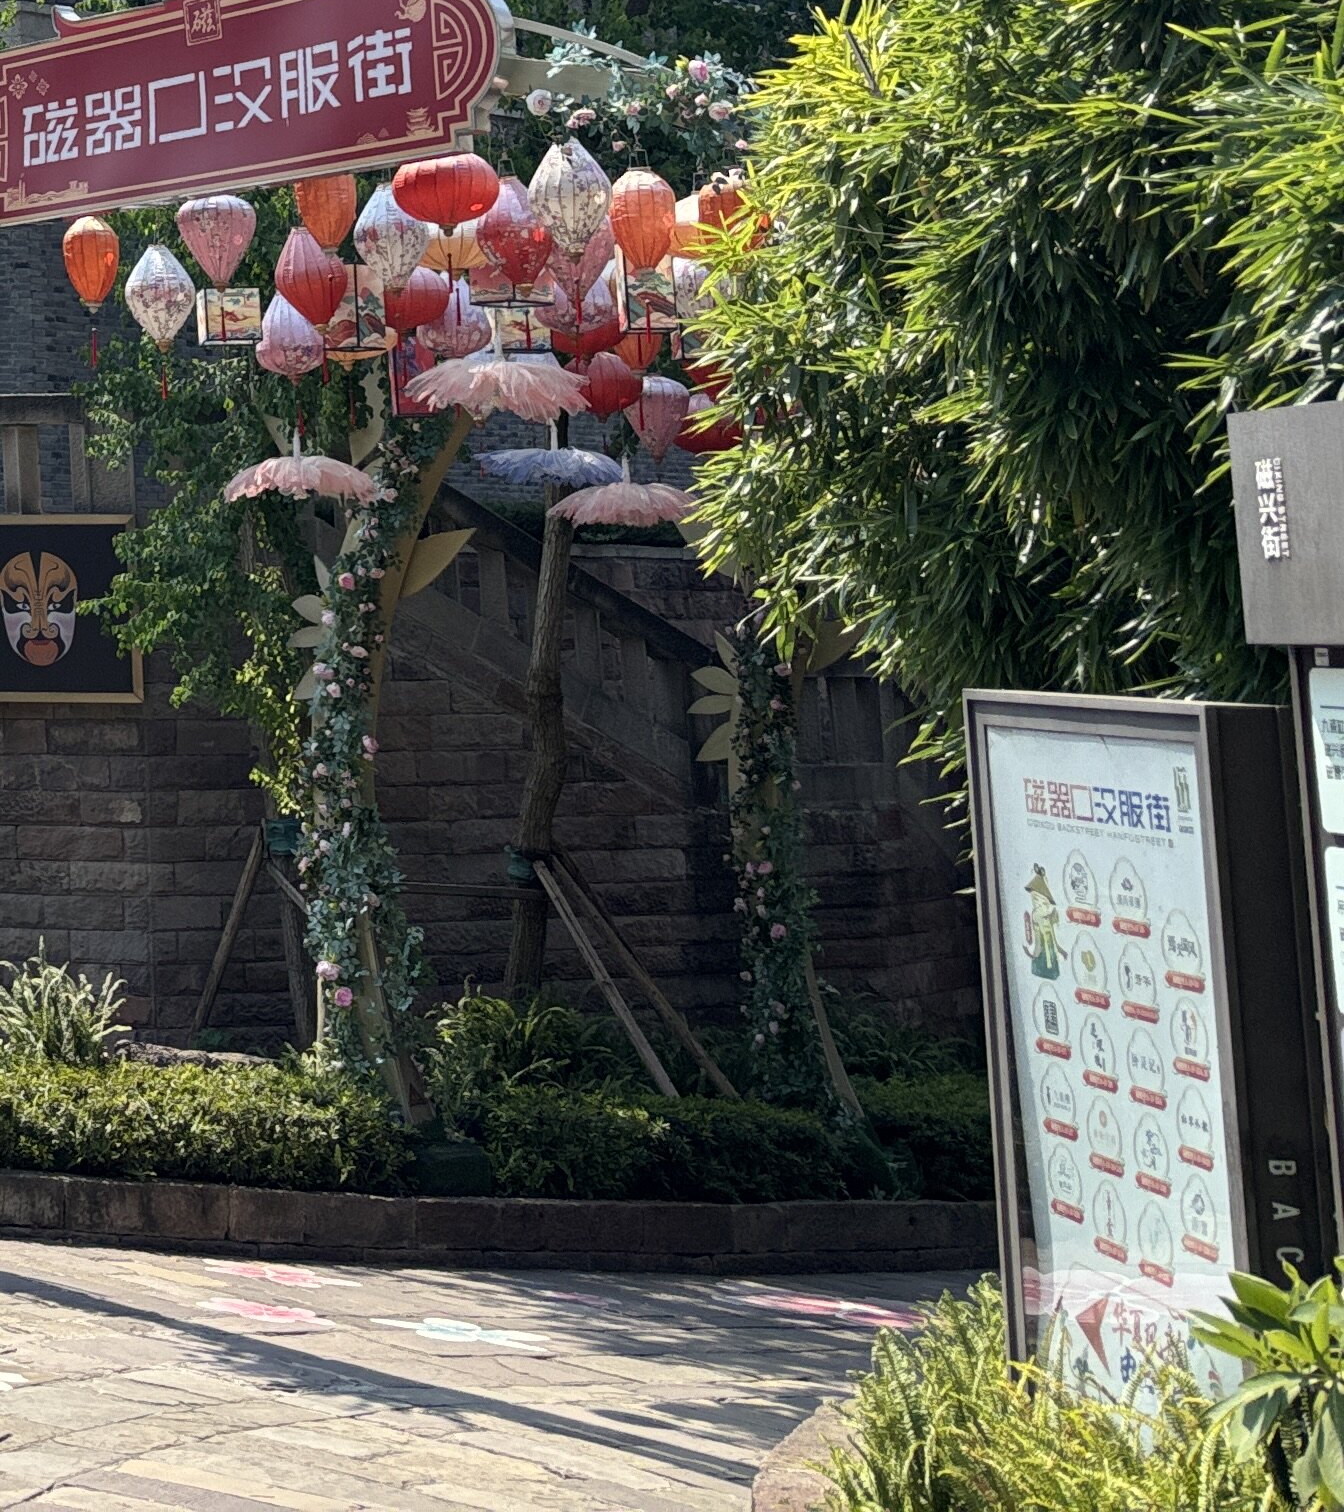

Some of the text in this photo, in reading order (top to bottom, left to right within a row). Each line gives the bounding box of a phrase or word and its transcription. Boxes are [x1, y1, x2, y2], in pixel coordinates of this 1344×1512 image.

[21, 26, 415, 168] 磁器口汉服街
[1022, 776, 1172, 833] 磁器口汉服街
